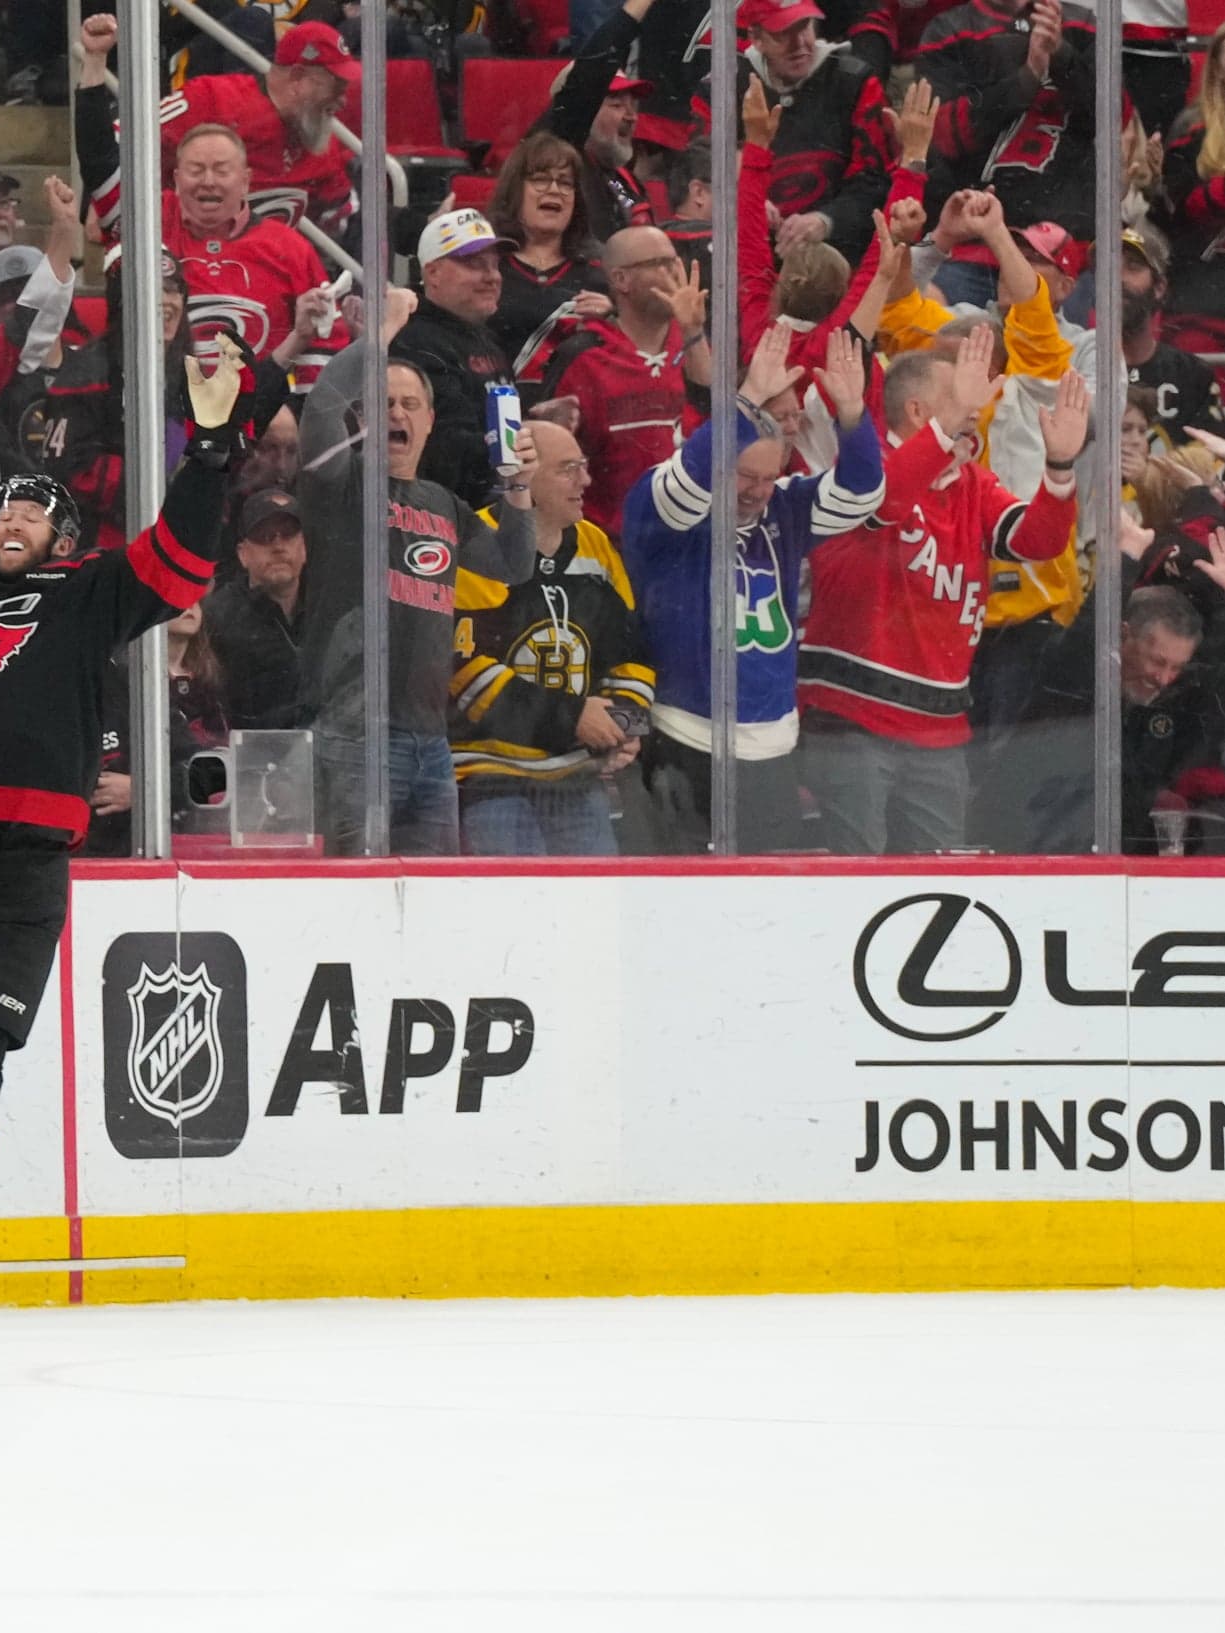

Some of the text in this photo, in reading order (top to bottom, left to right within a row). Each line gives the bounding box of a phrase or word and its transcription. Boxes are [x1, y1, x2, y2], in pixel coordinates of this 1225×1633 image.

[457, 211, 482, 226] CAN
[1157, 383, 1179, 418] C
[148, 1005, 203, 1085] NHL
[855, 1097, 1225, 1173] JOHNSO
